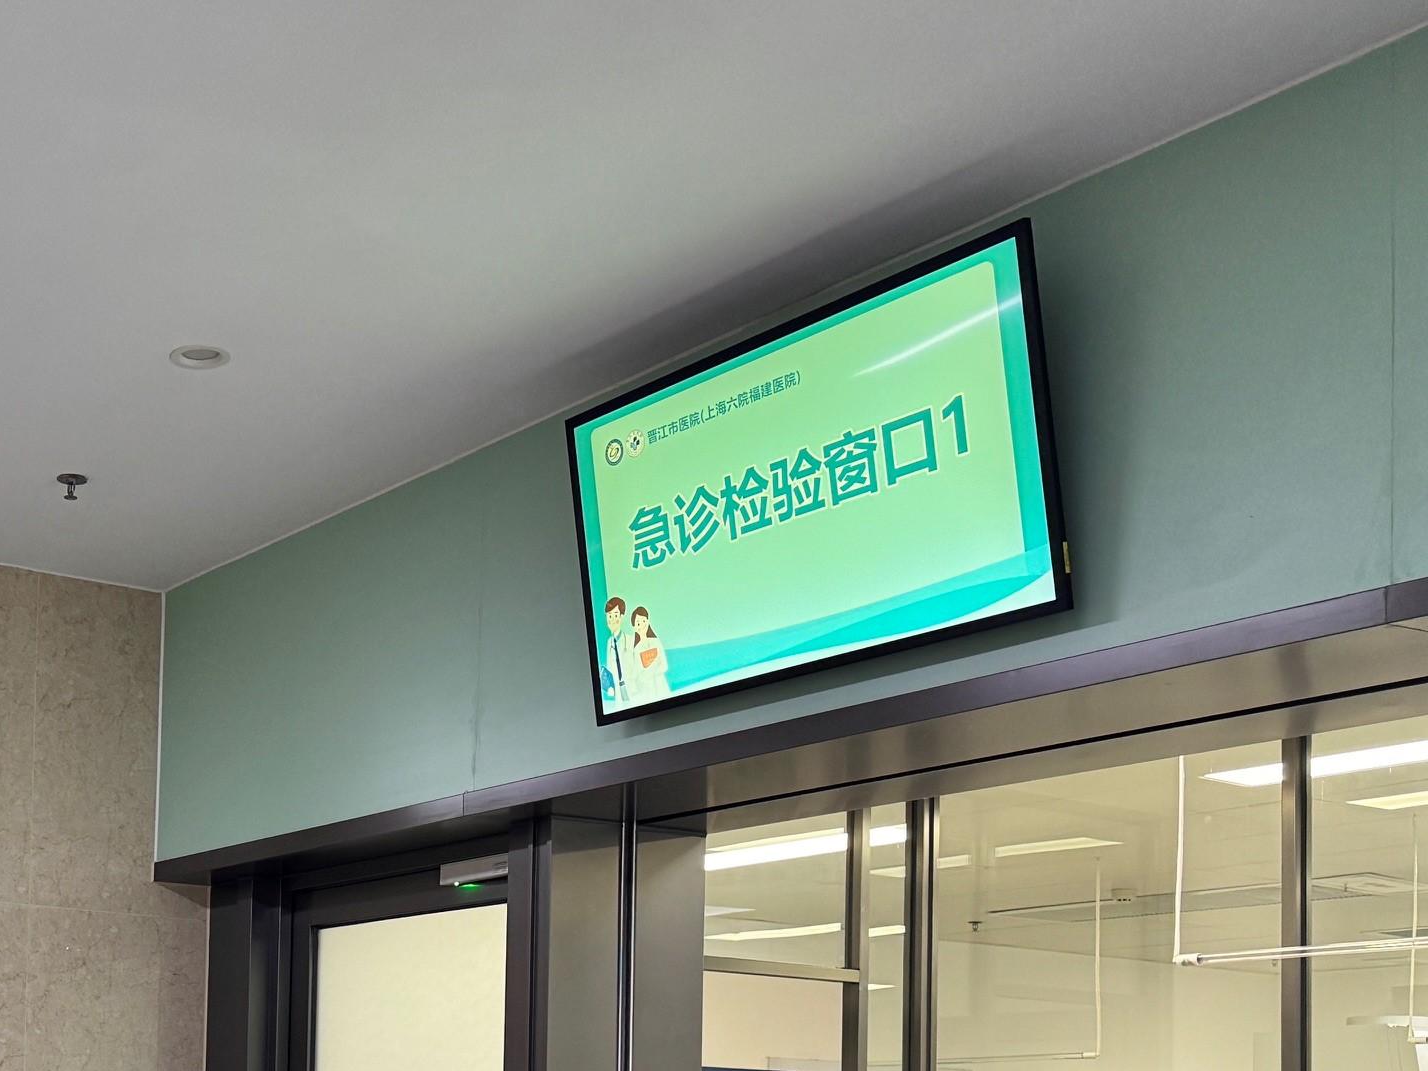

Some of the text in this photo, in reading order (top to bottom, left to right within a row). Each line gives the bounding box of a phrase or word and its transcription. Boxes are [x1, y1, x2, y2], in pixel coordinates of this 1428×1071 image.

[647, 370, 801, 444] 晋江市医院(上海六院福建医院)
[629, 394, 971, 570] 急诊检验窗口1
